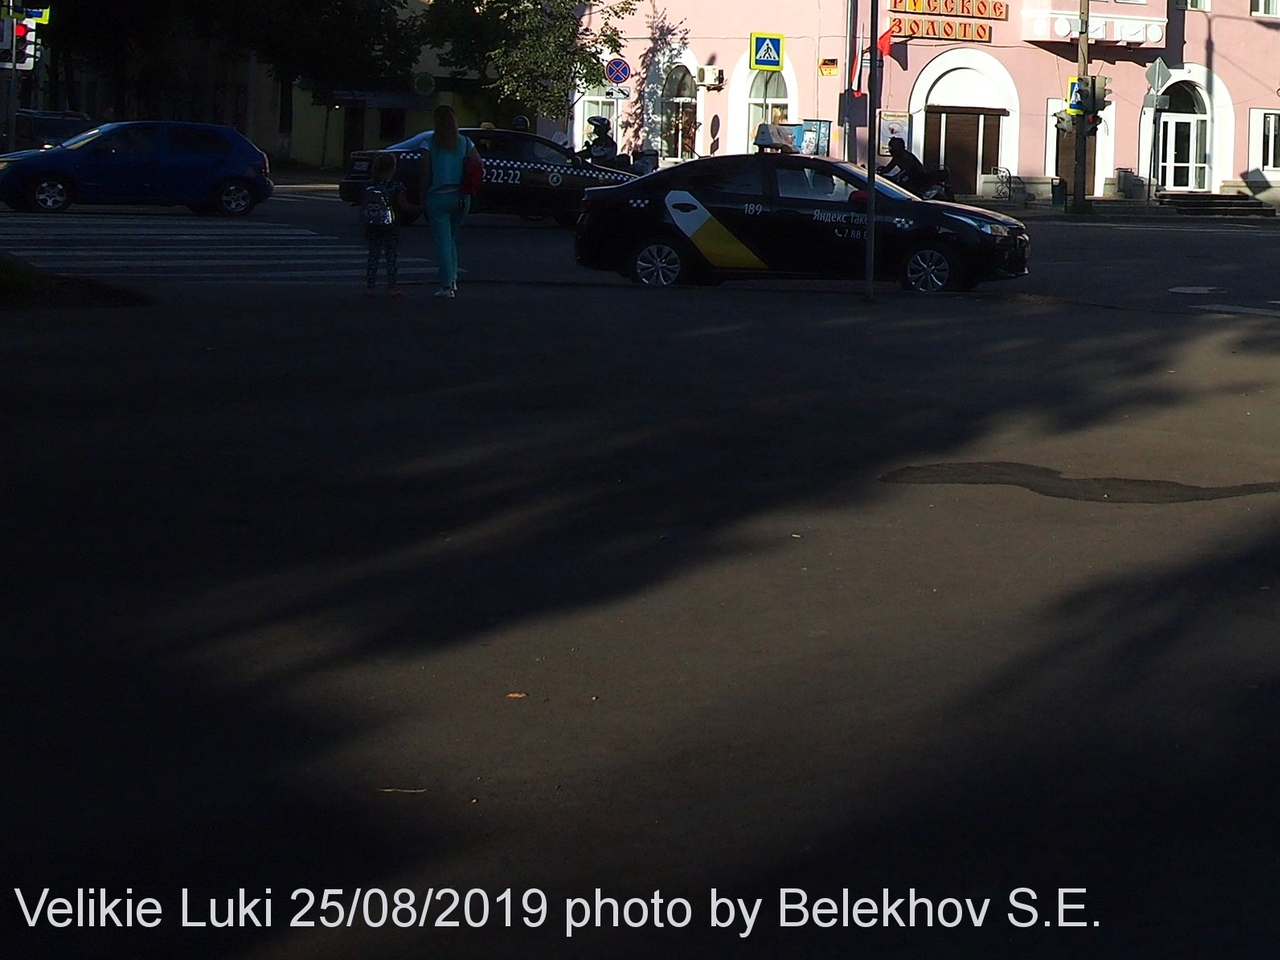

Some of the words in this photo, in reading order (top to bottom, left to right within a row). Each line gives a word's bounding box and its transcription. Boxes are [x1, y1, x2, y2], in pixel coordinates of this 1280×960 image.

[892, 17, 987, 39] ЗОЛОТО
[744, 202, 762, 215] 189
[813, 209, 847, 223] Яндекс
